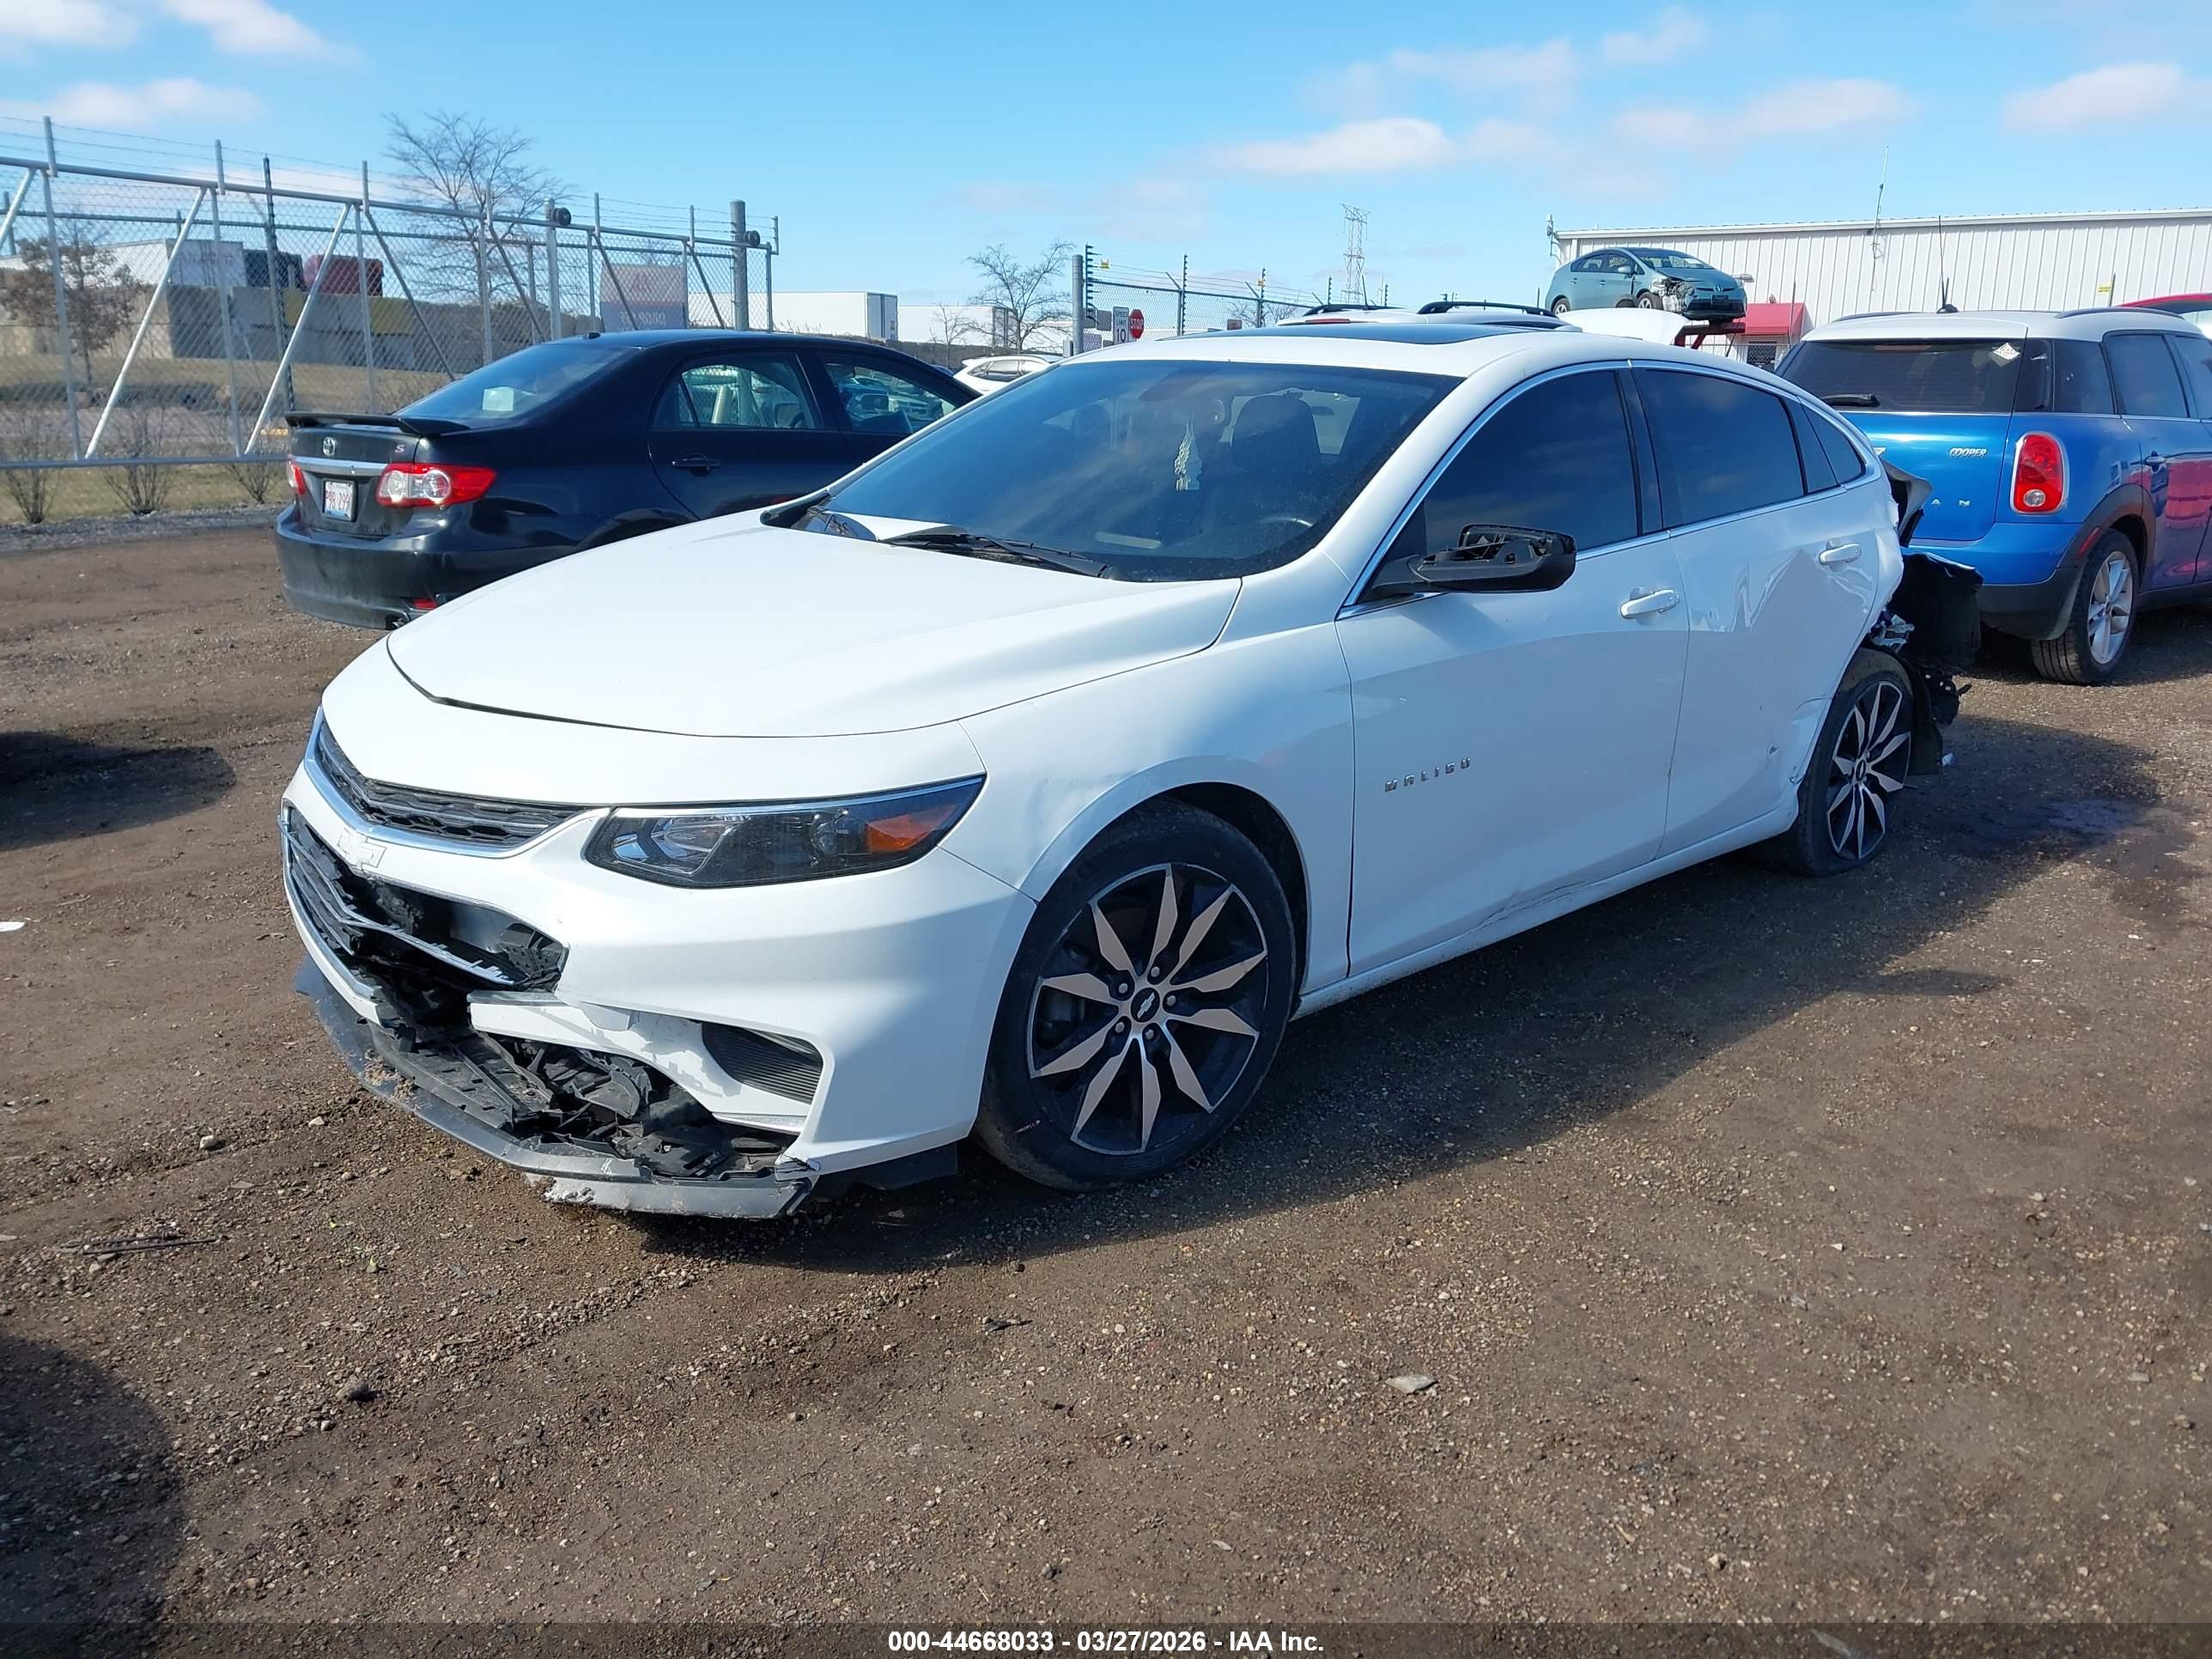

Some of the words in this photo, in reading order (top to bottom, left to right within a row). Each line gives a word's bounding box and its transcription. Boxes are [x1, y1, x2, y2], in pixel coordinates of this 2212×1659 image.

[1130, 318, 1143, 330] STOP
[1116, 329, 1127, 343] 10
[394, 444, 404, 453] S
[1949, 447, 1987, 458] COOPER
[1384, 757, 1471, 793] MALIBU
